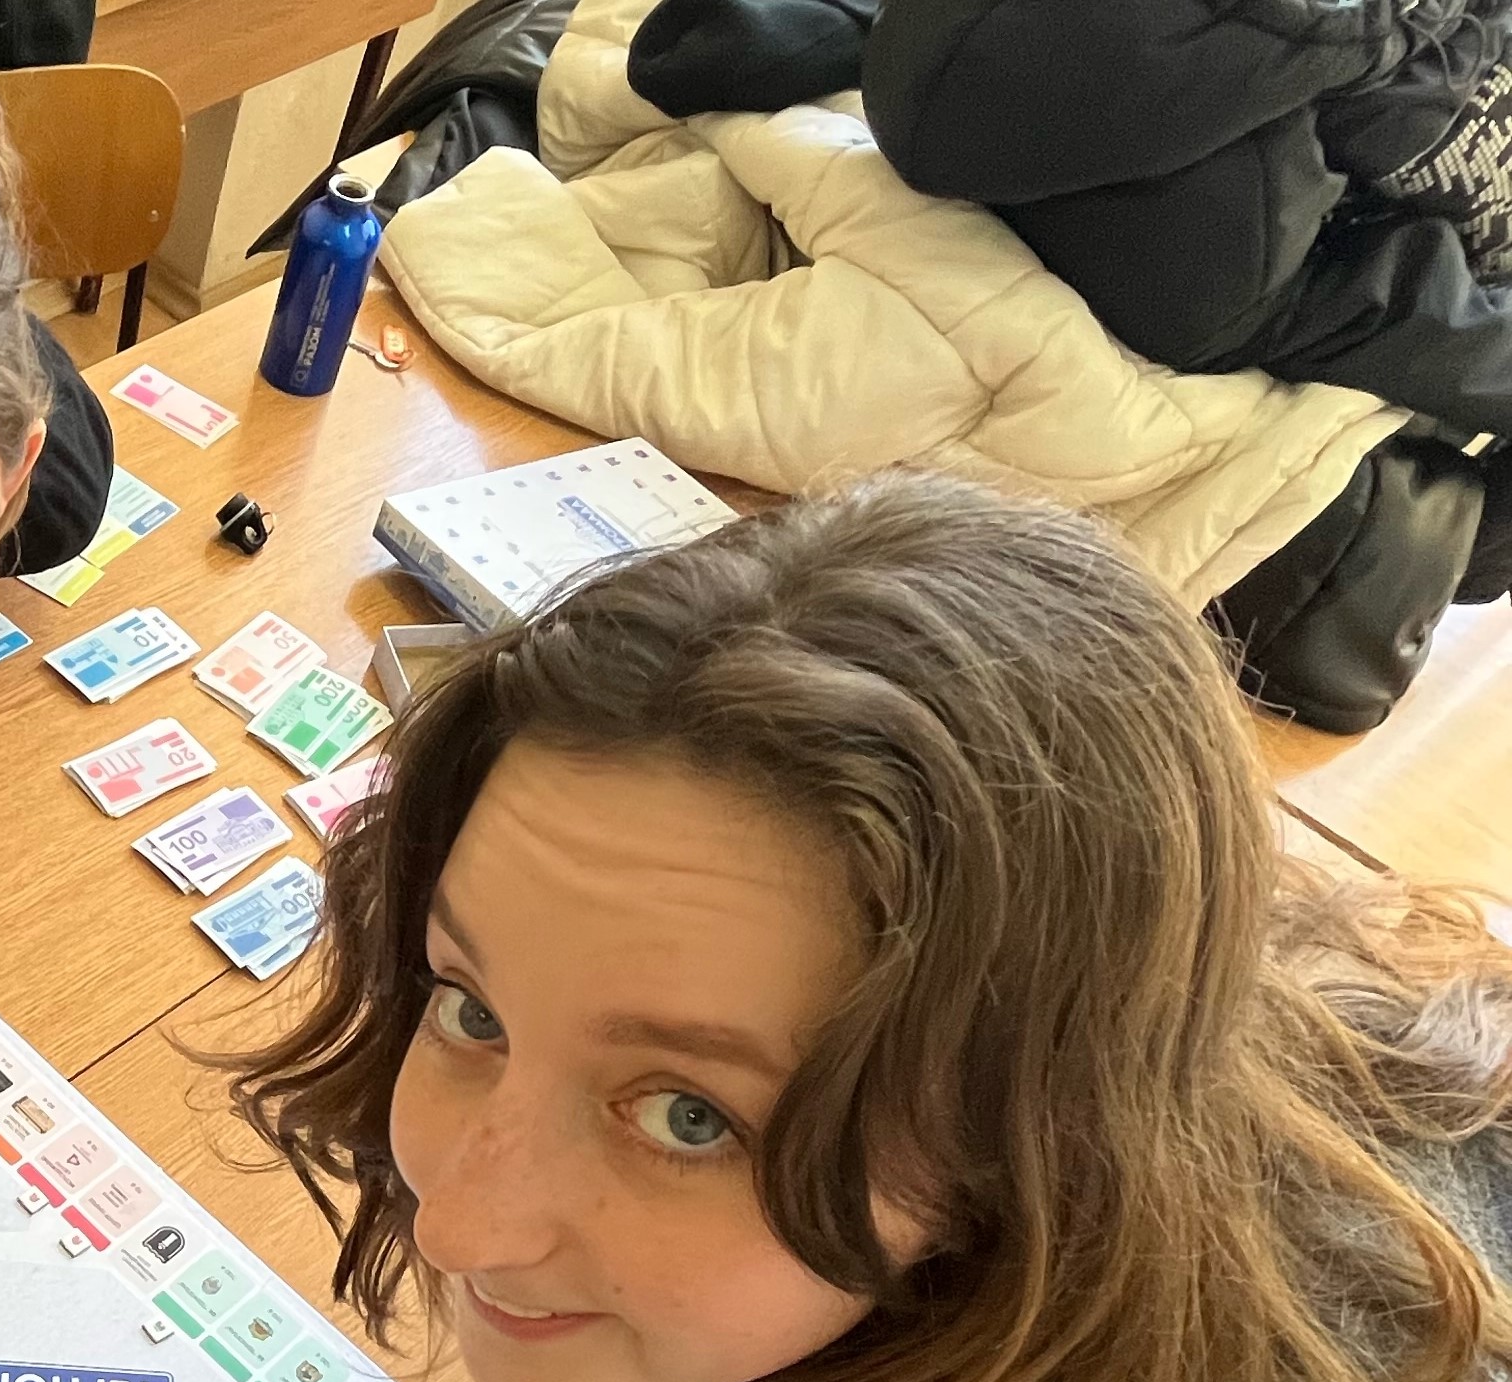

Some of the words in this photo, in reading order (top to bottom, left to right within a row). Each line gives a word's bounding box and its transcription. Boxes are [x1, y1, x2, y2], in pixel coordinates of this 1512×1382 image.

[132, 629, 160, 648] 10
[273, 630, 299, 650] 50
[313, 677, 346, 707] 200
[167, 745, 197, 768] 20
[169, 829, 208, 855] 100
